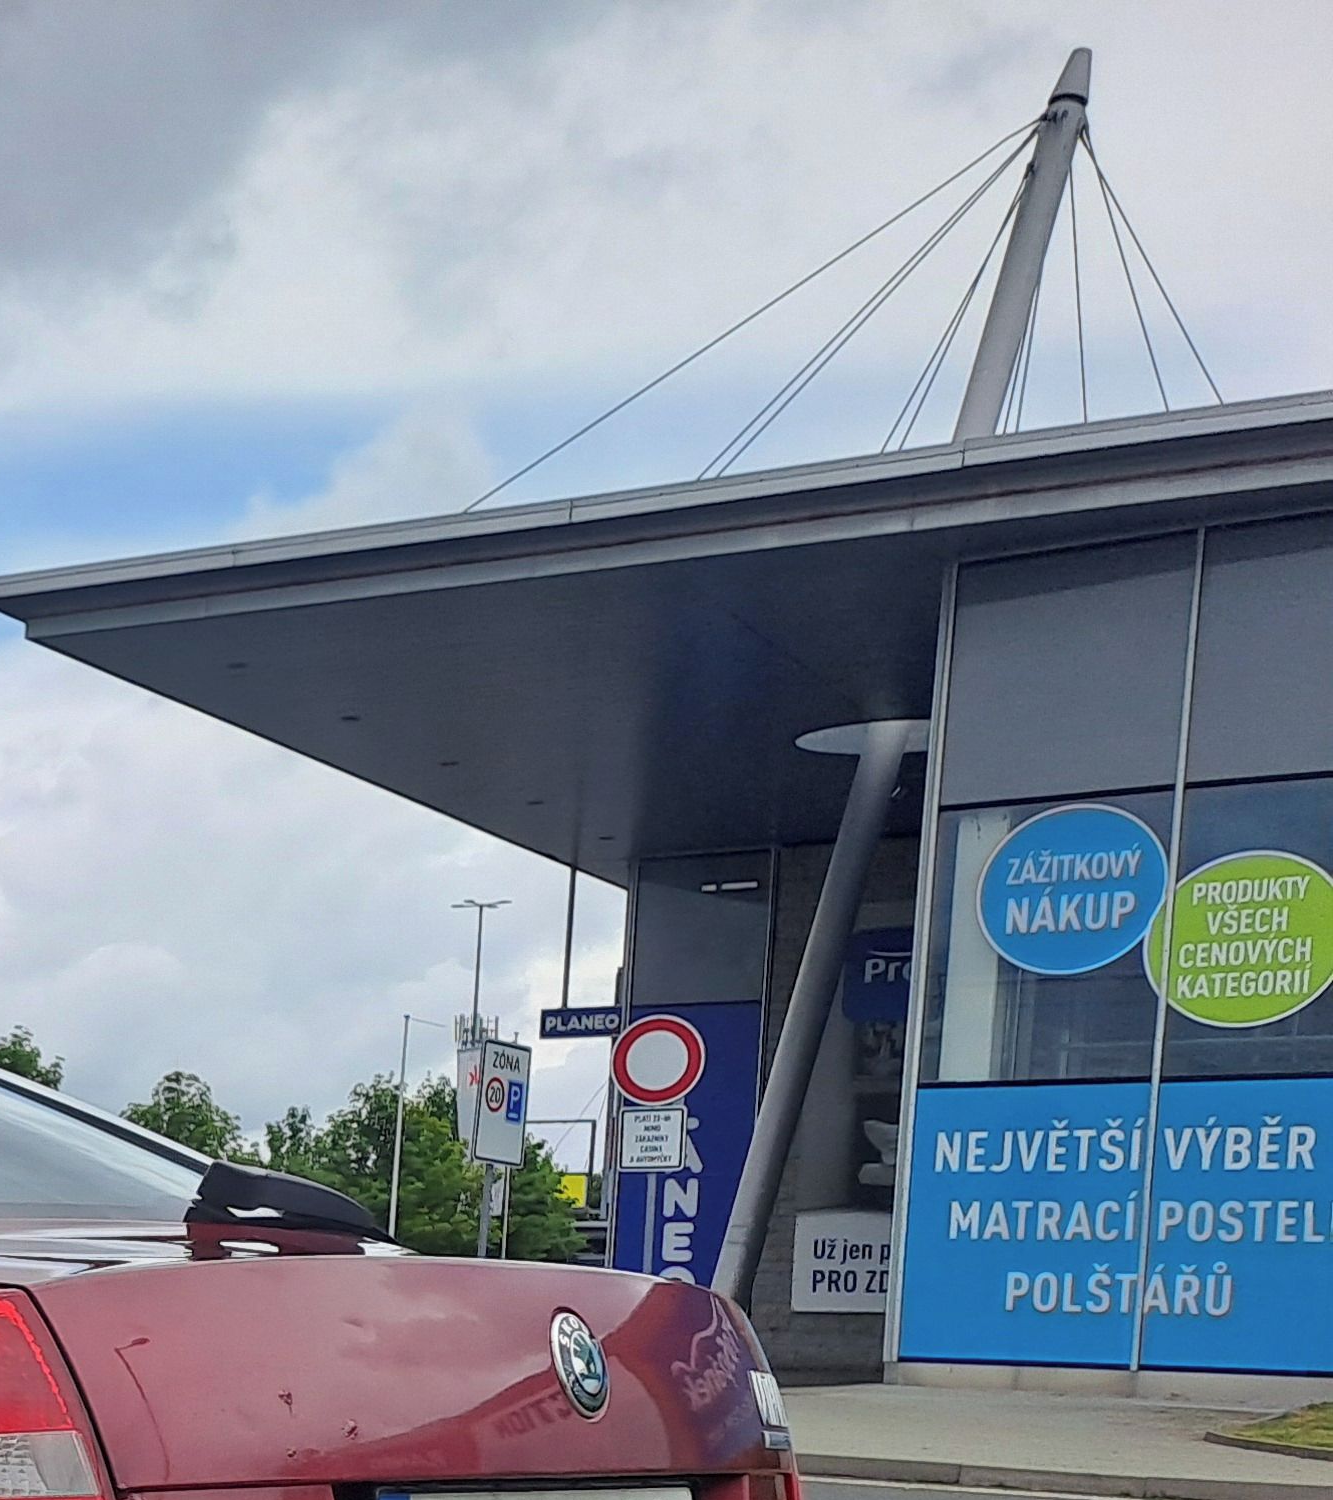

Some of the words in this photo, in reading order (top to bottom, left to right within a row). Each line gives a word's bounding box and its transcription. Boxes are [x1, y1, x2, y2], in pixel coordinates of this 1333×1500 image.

[1006, 842, 1142, 887] ZÁŽITKOVÝ
[1192, 875, 1311, 906] PRODUKTY
[1005, 886, 1137, 935] NÁKUP
[1206, 899, 1289, 935] VŠECH
[1178, 931, 1313, 969] CENOVÝCH
[864, 958, 911, 984] Pr
[1177, 963, 1311, 1000] KATEGORIÍ
[545, 1013, 620, 1032] PLANEO
[492, 1050, 521, 1073] ZÓNA
[489, 1086, 501, 1103] 20
[510, 1085, 521, 1109] P
[934, 1117, 1147, 1173] NEJVĚTŠÍ
[1163, 1114, 1317, 1171] VÝBĚR
[948, 1189, 1140, 1242] MATRACÍ
[813, 1237, 837, 1260] Už
[840, 1238, 873, 1265] jen
[812, 1269, 858, 1293] PRO
[1004, 1260, 1234, 1317] POLŠTÁŘŮ
